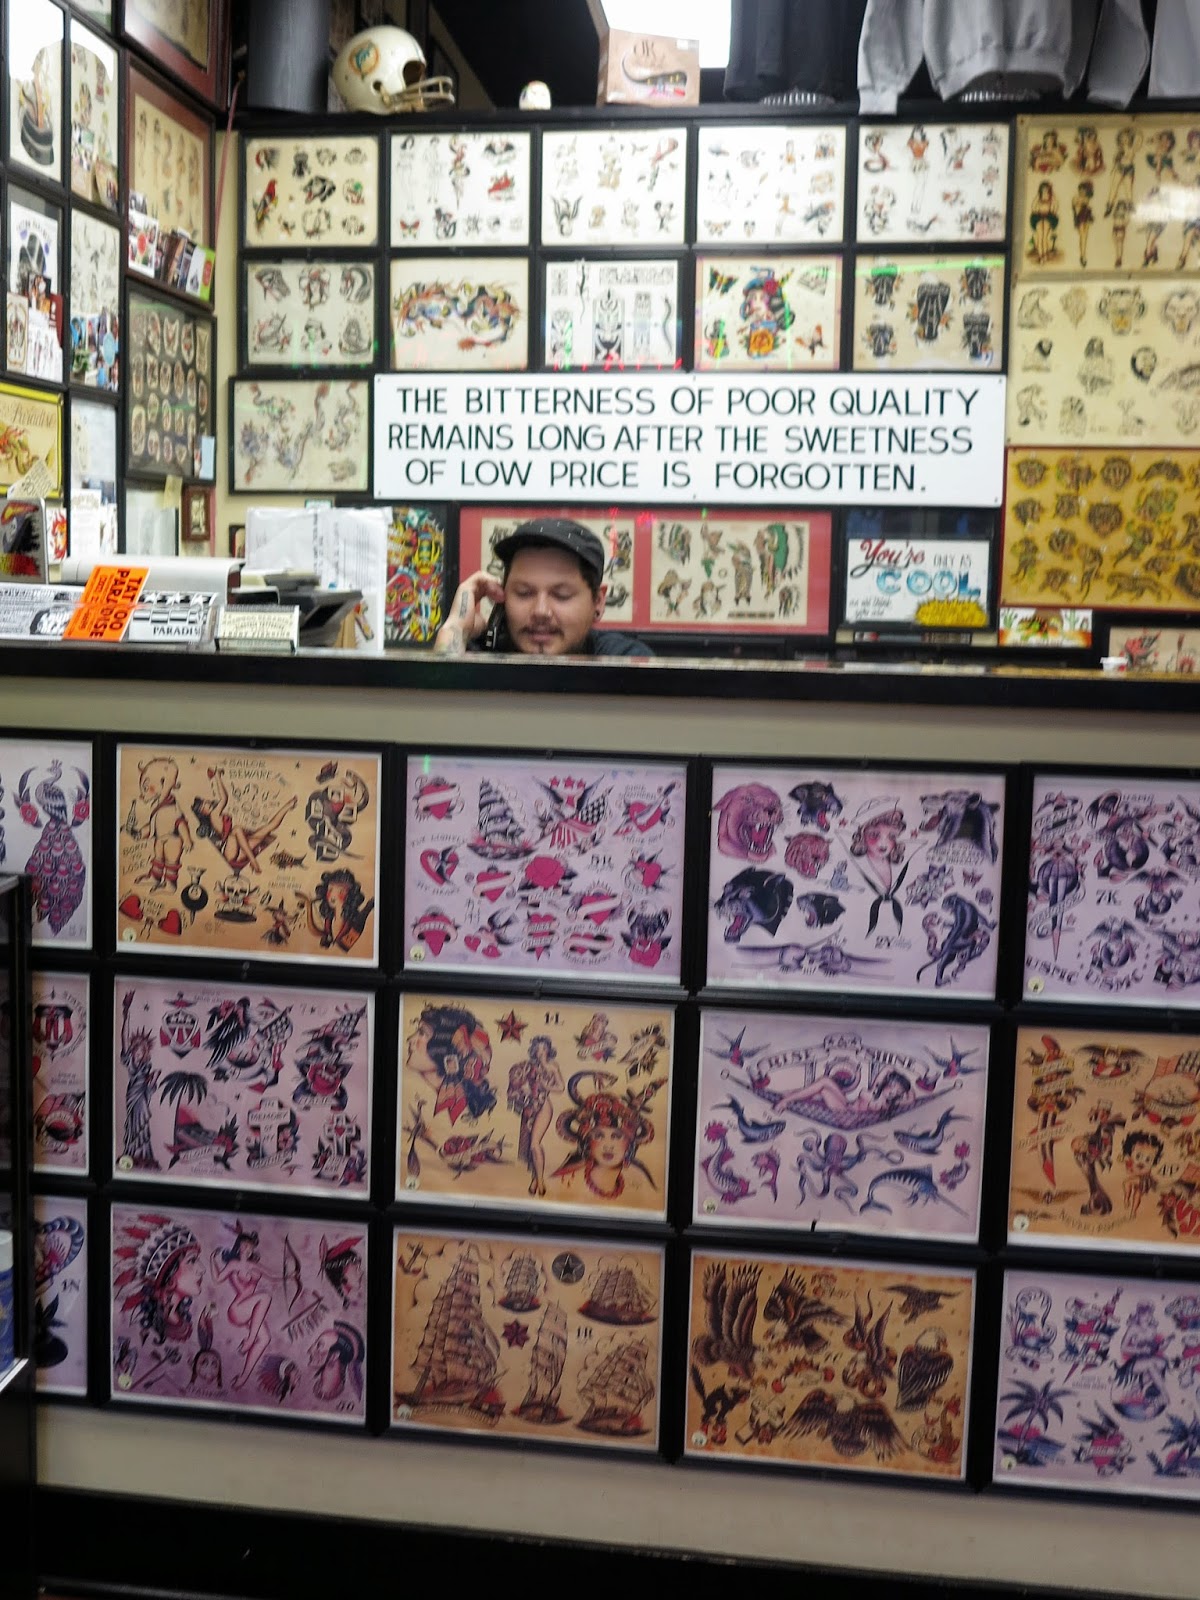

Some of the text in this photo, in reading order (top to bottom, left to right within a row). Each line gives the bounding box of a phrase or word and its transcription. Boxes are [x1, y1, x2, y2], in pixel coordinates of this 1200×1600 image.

[396, 387, 980, 416] THE BITTERNESS OF POOR QUALITY
[388, 424, 974, 454] REMAINS LONG AFTER THE SWEETNESS
[405, 459, 927, 492] OF LOW PRICE IS FORGOTTEN.
[850, 538, 926, 579] You're
[875, 569, 982, 597] COOL
[108, 575, 143, 631] TATOO
[228, 758, 266, 768] SAILOR
[1096, 889, 1122, 906] 7K
